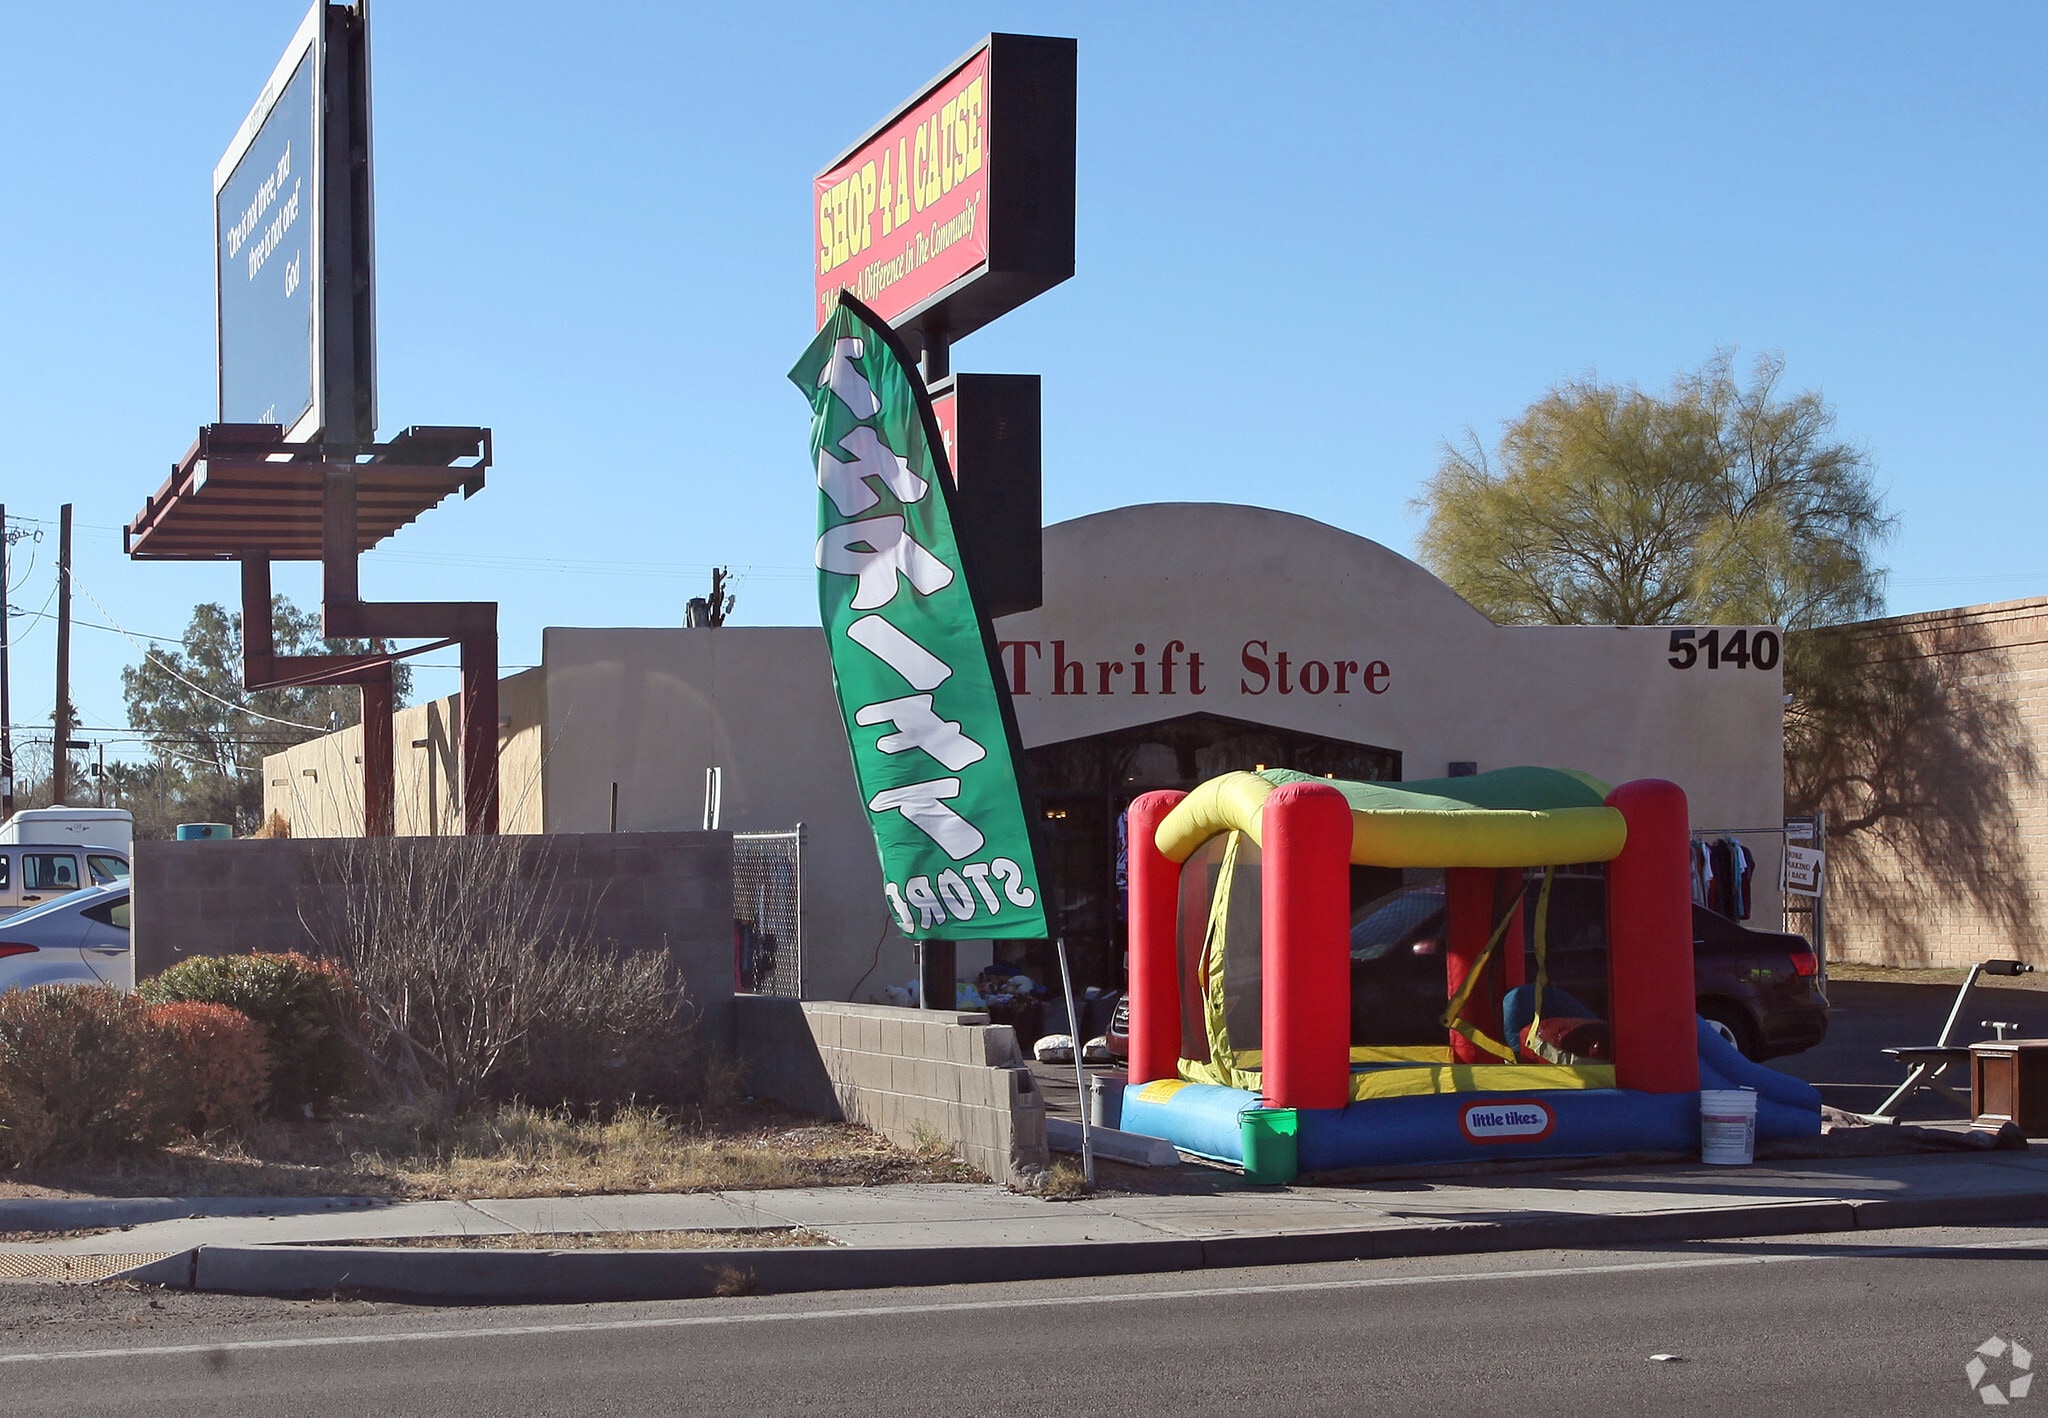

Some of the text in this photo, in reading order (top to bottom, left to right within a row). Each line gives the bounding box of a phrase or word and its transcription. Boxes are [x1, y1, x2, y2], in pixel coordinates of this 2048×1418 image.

[242, 211, 247, 243] is
[247, 194, 258, 235] not
[277, 140, 290, 190] and
[819, 75, 983, 276] SHOP 4 A CAUSE
[249, 246, 264, 281] three
[265, 225, 270, 259] is
[271, 208, 282, 251] not
[285, 249, 300, 298] God
[857, 272, 863, 302] A
[865, 253, 904, 302] Difference
[906, 240, 914, 275] In
[915, 231, 929, 268] The
[998, 640, 1390, 695] Thrift Store
[1667, 629, 1779, 670] 5140
[1472, 1113, 1504, 1128] little
